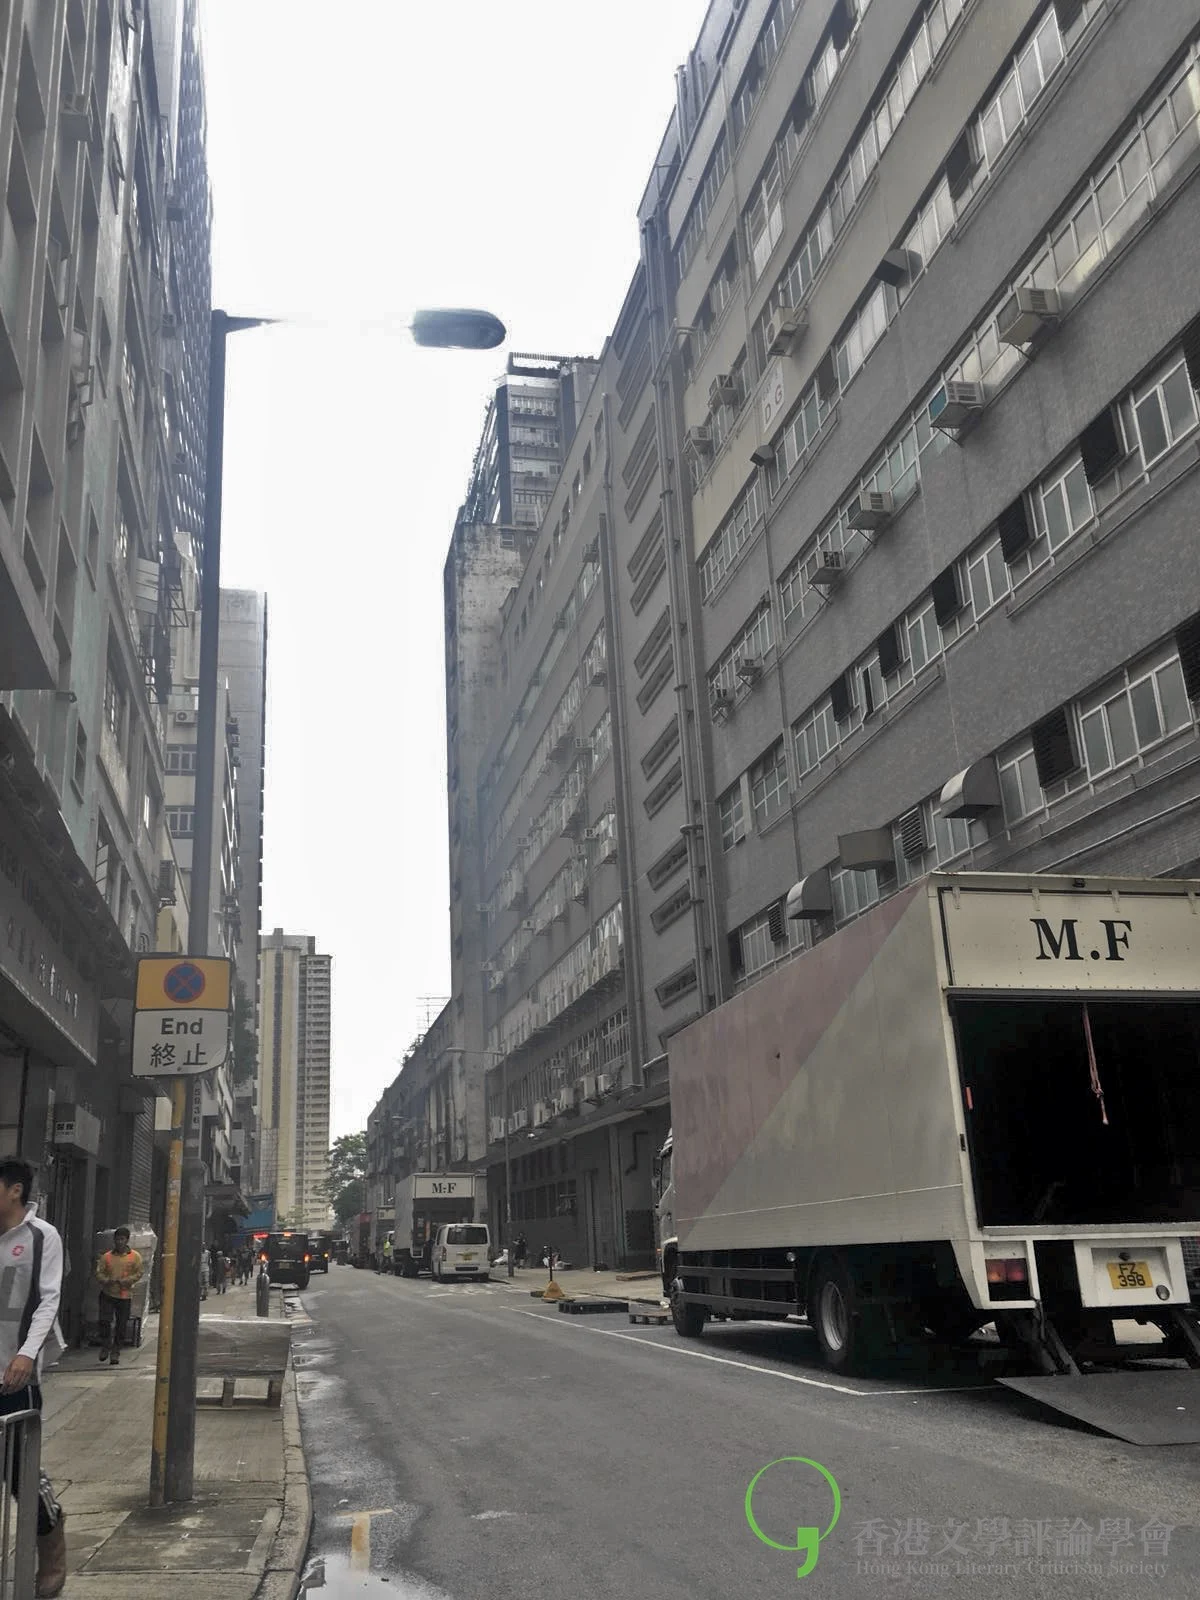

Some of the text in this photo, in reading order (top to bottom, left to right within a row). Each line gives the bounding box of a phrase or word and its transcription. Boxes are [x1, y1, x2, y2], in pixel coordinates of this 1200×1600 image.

[1029, 918, 1133, 961] M.F
[160, 1017, 204, 1035] End
[150, 1042, 208, 1068] 終止
[1118, 1262, 1138, 1275] FZ
[1118, 1274, 1146, 1287] 398
